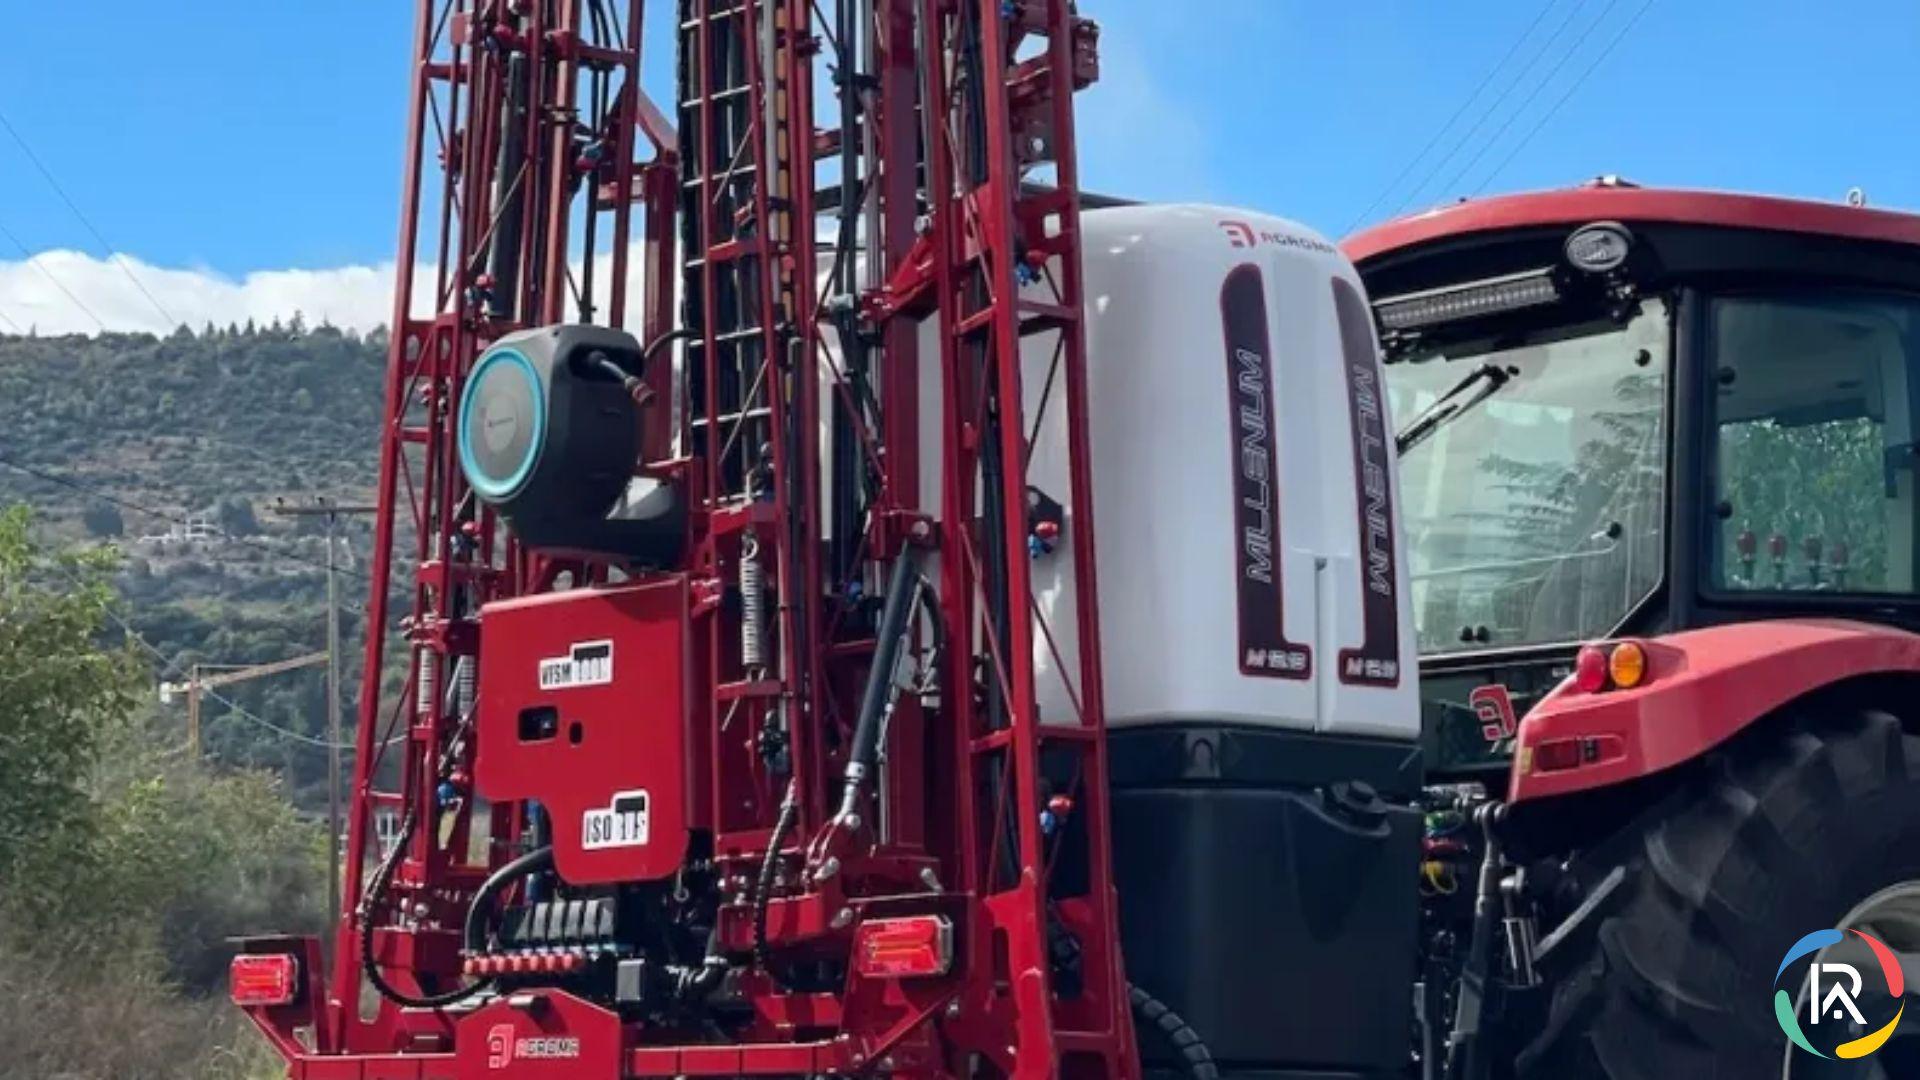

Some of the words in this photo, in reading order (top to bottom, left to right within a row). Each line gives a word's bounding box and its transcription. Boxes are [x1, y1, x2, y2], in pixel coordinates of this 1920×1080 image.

[1236, 348, 1272, 584] MILLENIUM
[1353, 363, 1391, 596] MILLENIUM
[585, 814, 612, 844] ISO
